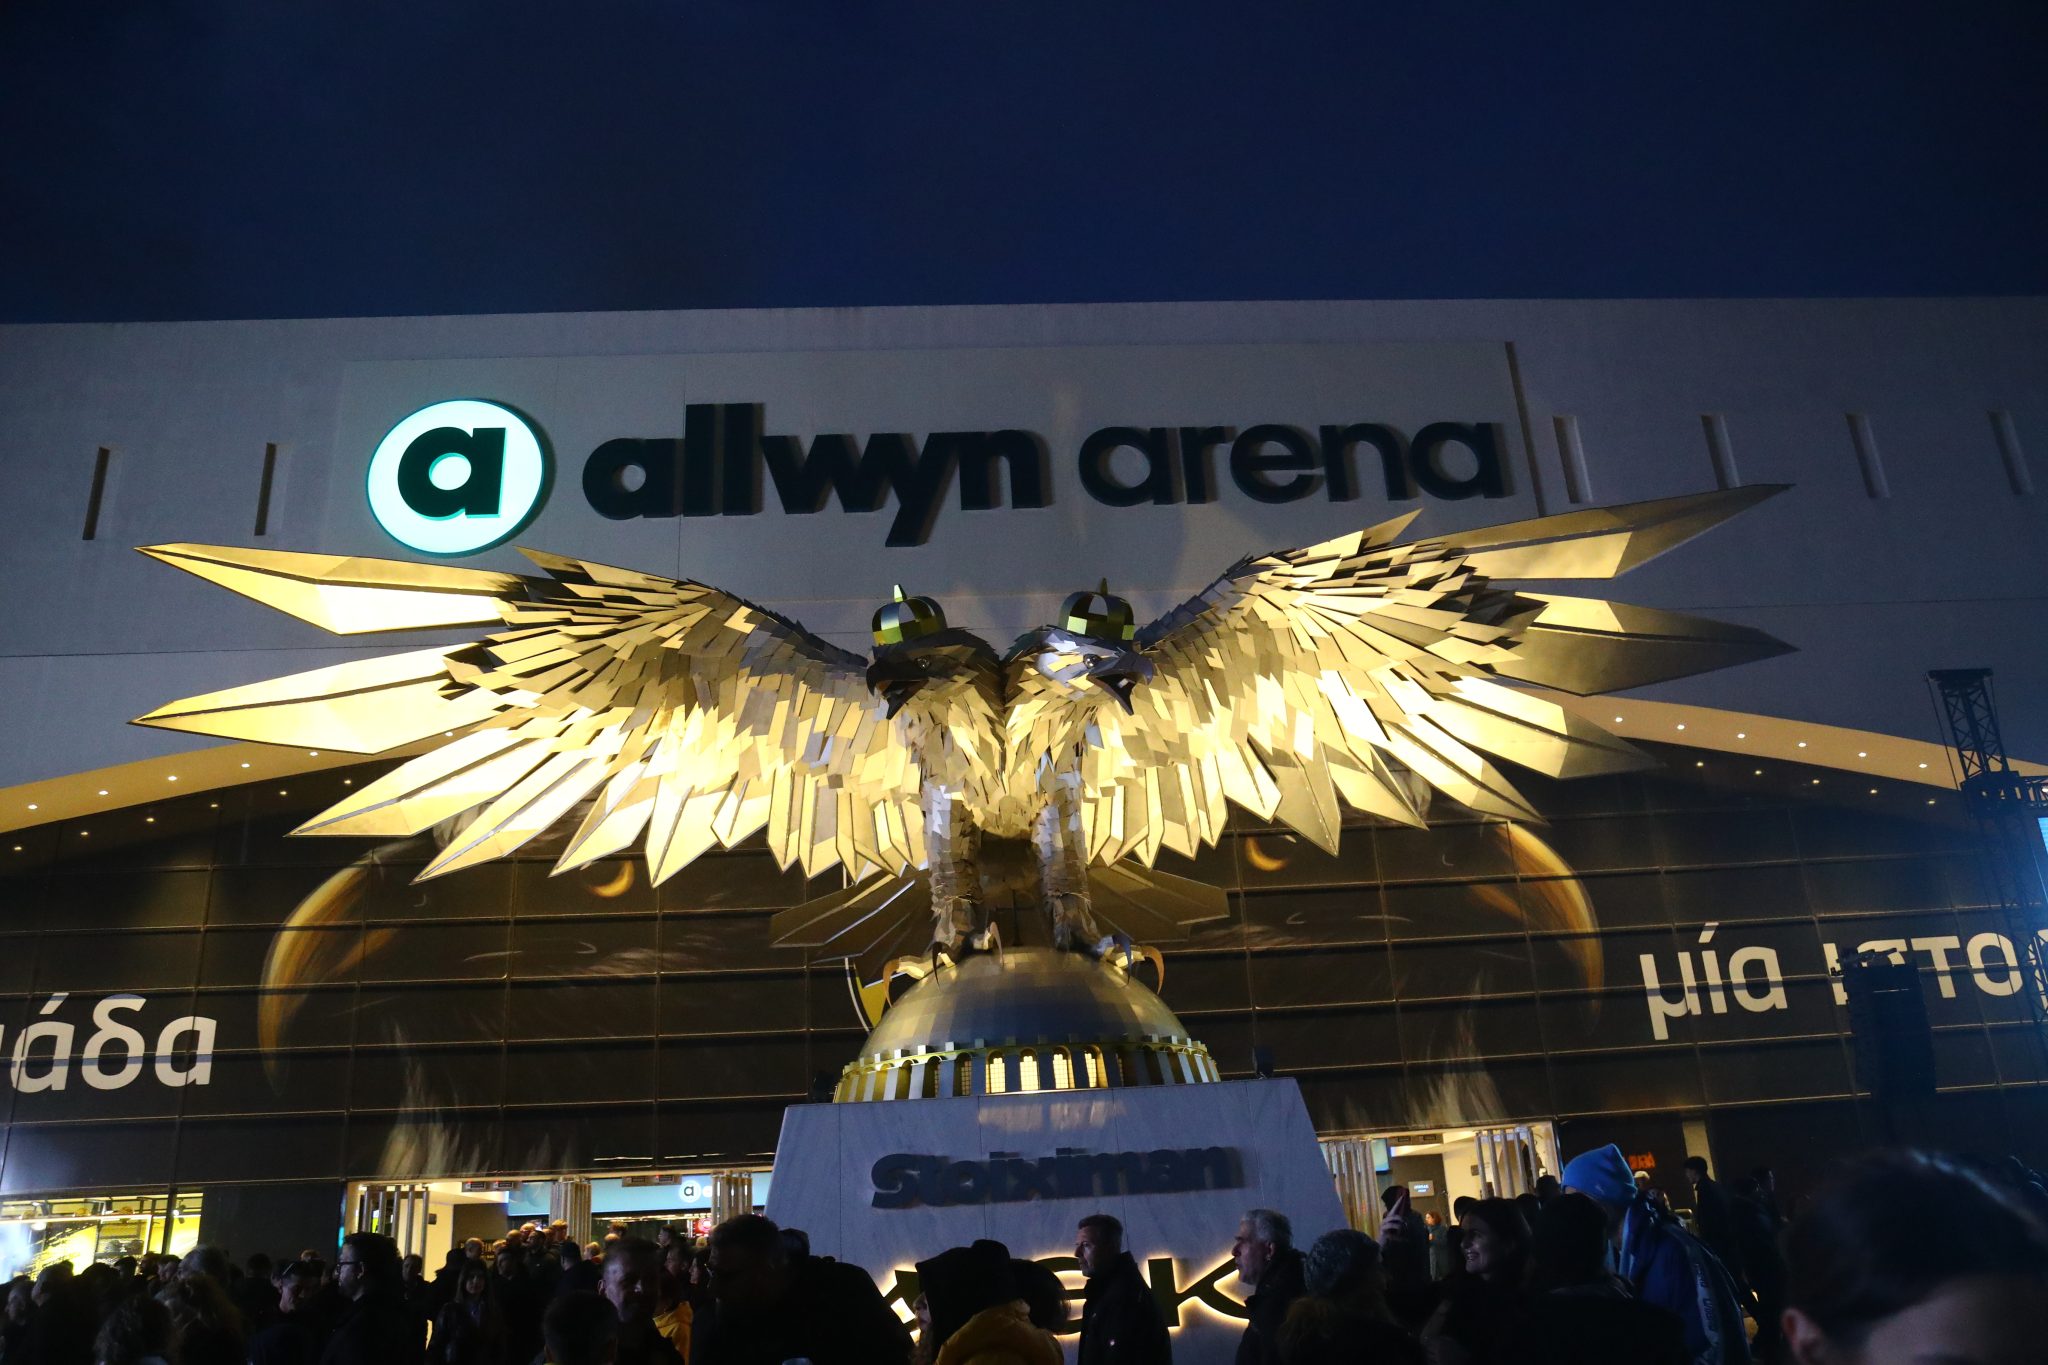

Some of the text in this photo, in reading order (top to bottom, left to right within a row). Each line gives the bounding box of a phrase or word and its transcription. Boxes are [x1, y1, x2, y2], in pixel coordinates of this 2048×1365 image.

[582, 402, 1047, 547] allwyn
[1079, 421, 1507, 507] arena
[1640, 922, 1788, 1040] μία
[0, 992, 217, 1093] άδα
[871, 1145, 1238, 1209] Stoiximan
